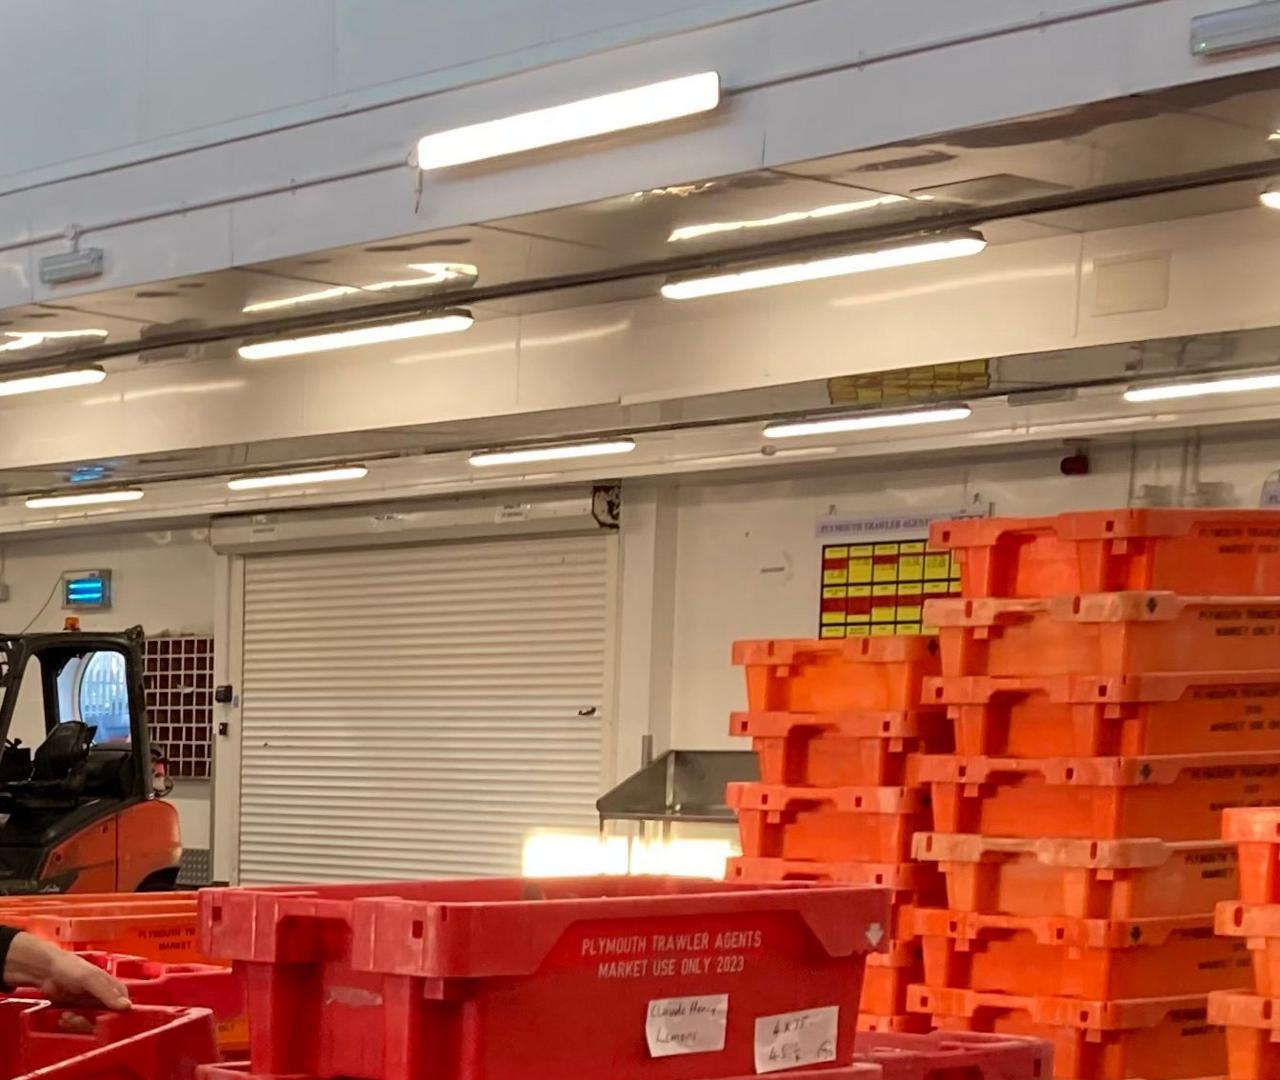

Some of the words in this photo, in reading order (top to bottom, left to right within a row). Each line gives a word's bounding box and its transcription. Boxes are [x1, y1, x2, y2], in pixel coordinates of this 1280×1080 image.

[902, 518, 930, 528] AGENT
[581, 934, 647, 956] PLYMOUTH
[652, 932, 709, 950] TRAWLER
[715, 930, 762, 949] AGENTS
[598, 959, 648, 979] MARKET
[653, 958, 675, 976] USE
[680, 957, 710, 975] ONLY
[717, 955, 745, 973] 2023
